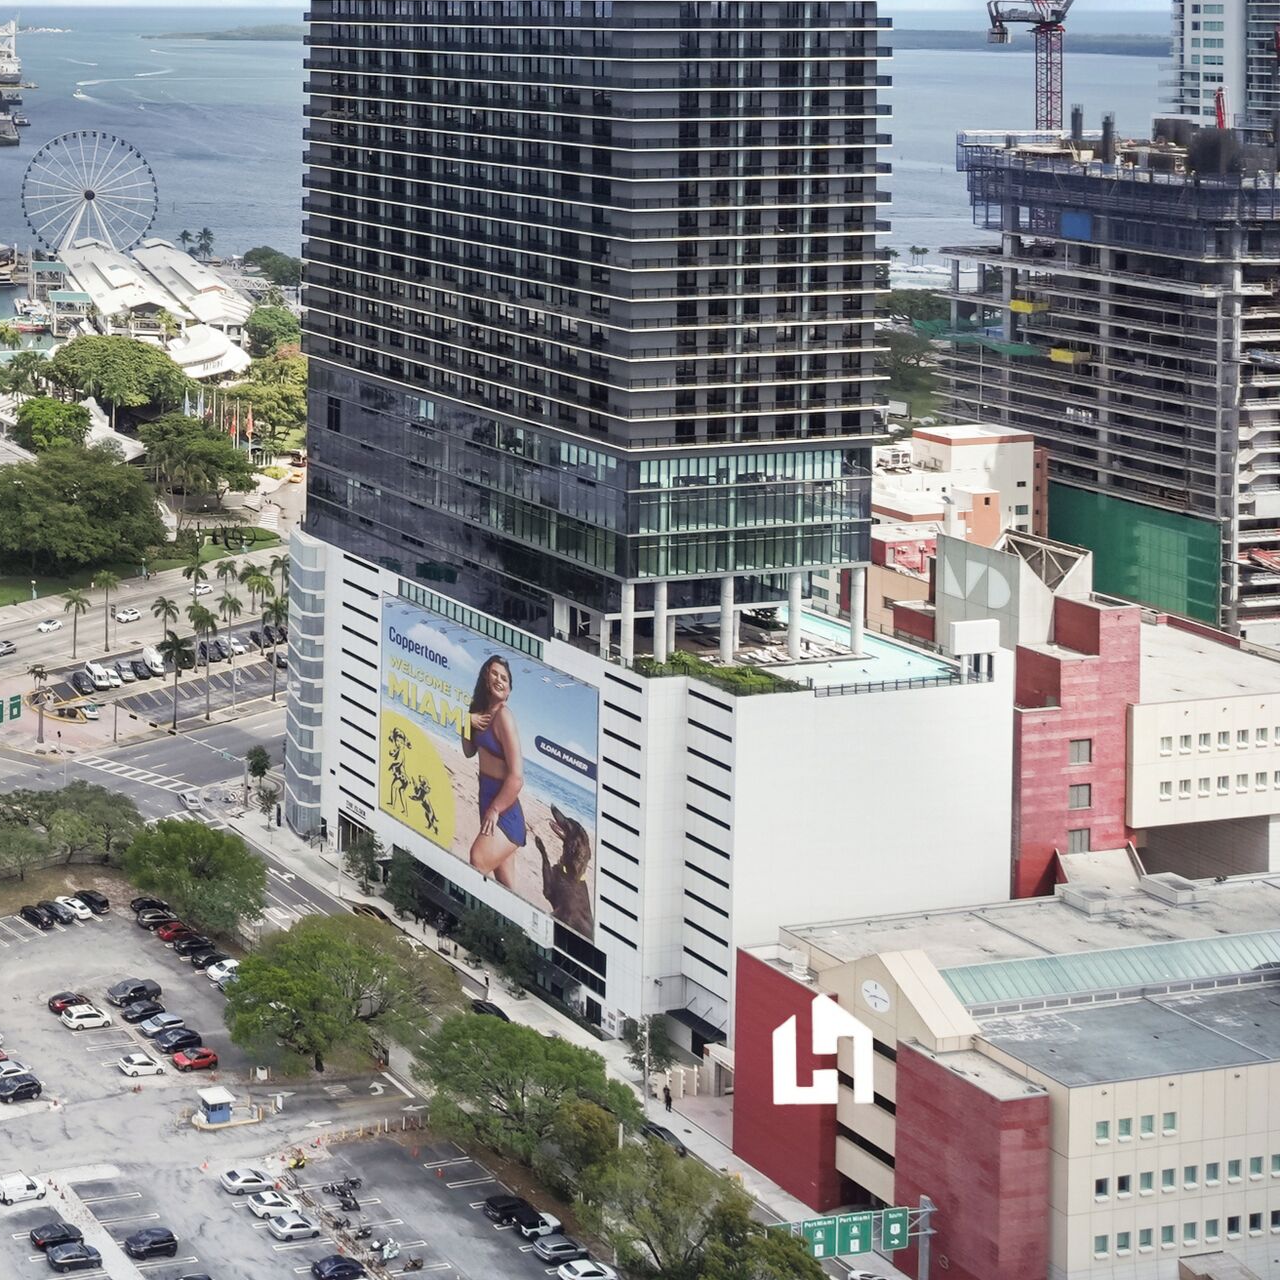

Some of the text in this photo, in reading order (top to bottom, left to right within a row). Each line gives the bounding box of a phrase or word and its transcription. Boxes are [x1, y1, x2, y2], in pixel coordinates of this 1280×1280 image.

[388, 626, 449, 669] Coppertone
[389, 655, 473, 707] WELCOME TO
[387, 671, 472, 740] MIAMI
[540, 742, 589, 772] ILONA MAHER
